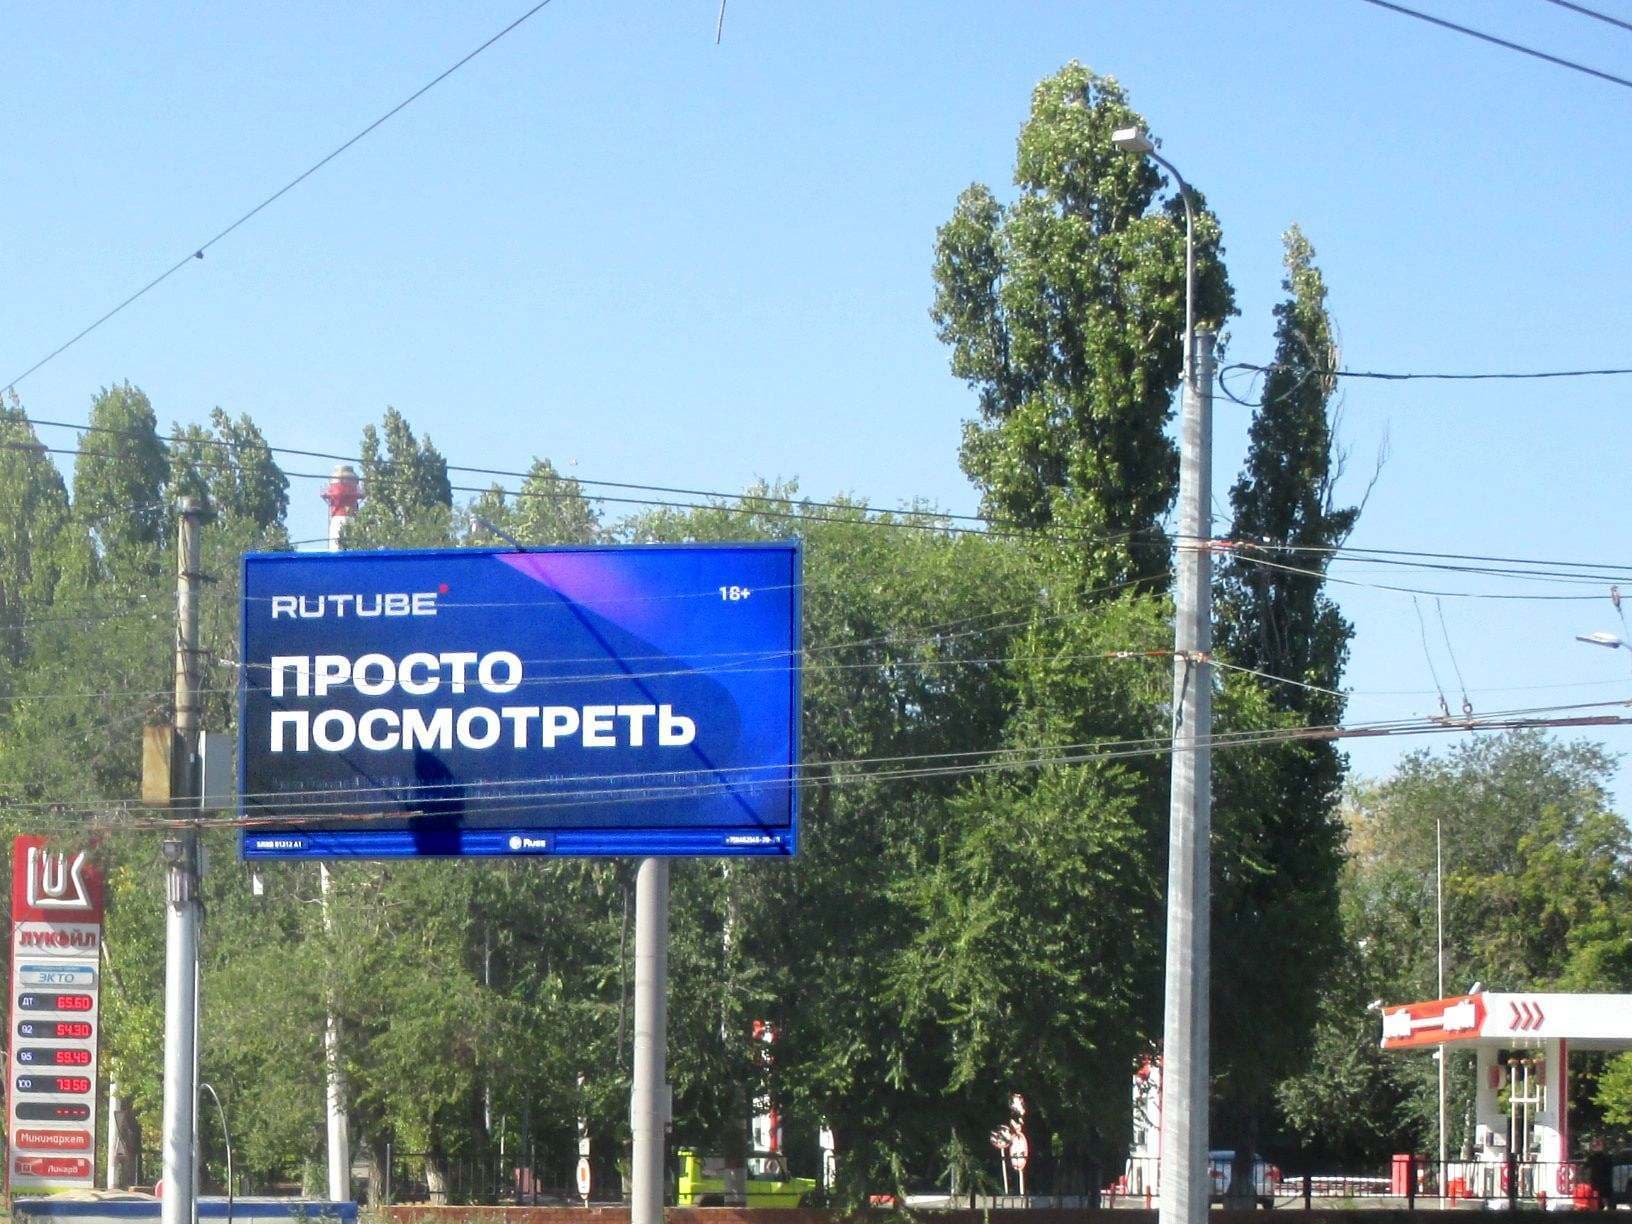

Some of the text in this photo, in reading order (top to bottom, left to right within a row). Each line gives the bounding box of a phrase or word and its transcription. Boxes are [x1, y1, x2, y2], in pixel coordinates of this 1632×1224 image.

[718, 585, 751, 601] 18+
[271, 592, 438, 619] RUTUBE
[270, 650, 523, 697] ПРОСТО
[270, 704, 696, 752] ПОСМОТРЕТЬ
[21, 1024, 33, 1034] 92
[20, 1052, 32, 1061] 95
[21, 1132, 85, 1146] Минимаркет
